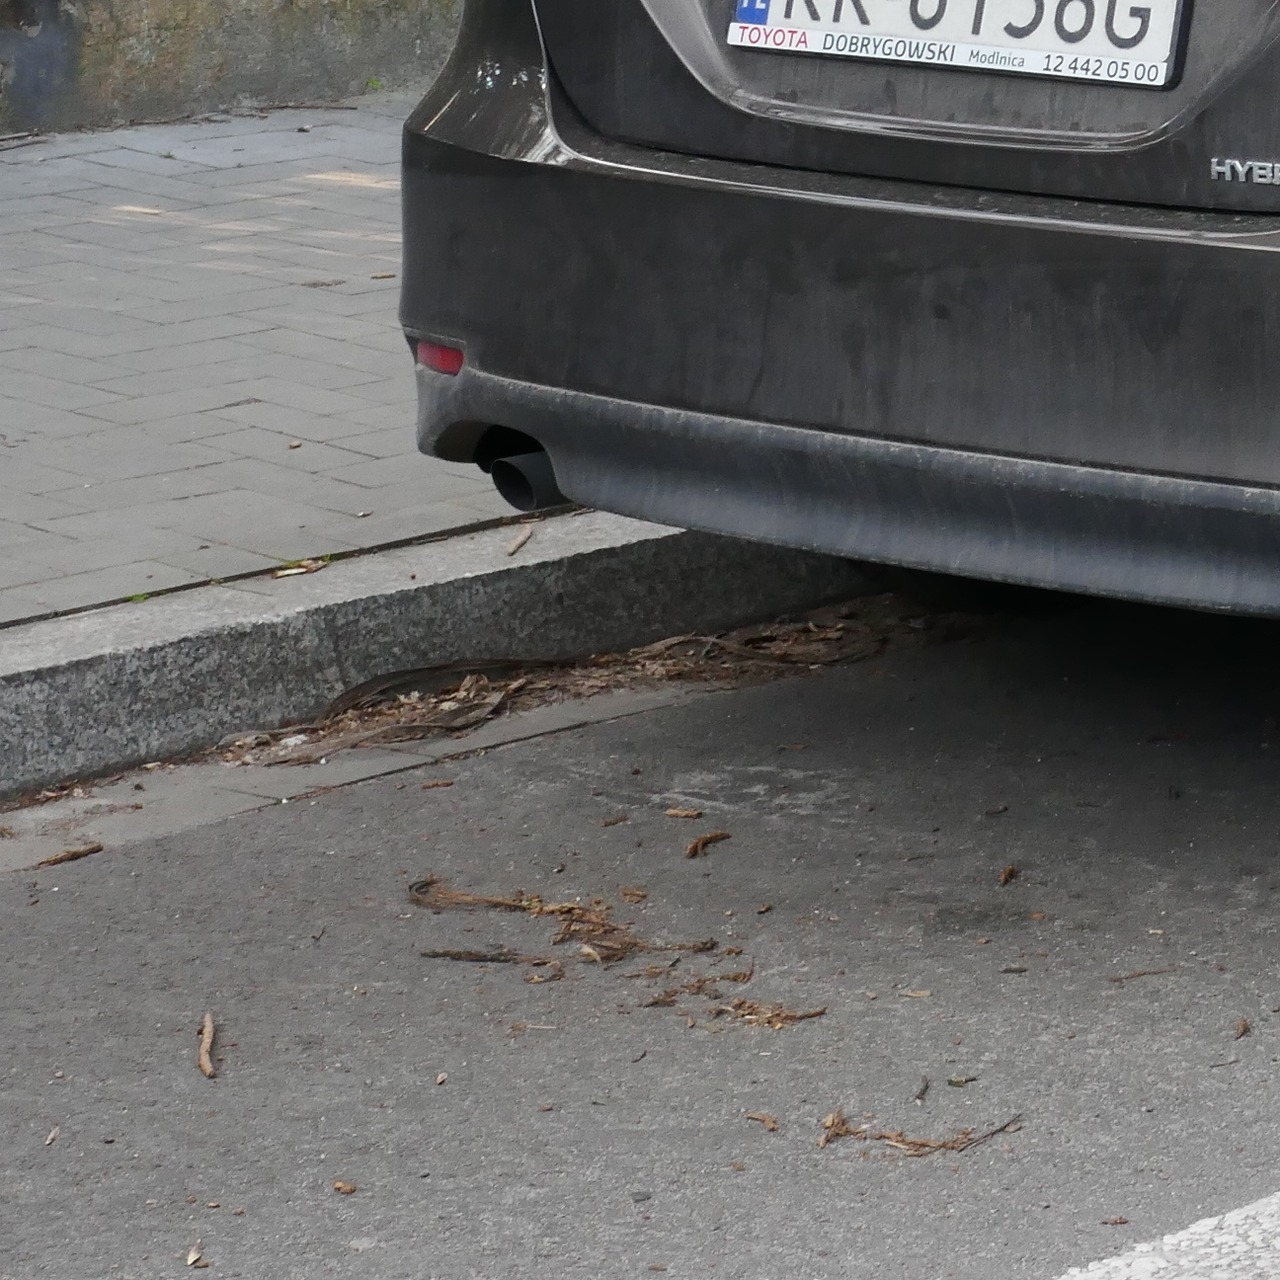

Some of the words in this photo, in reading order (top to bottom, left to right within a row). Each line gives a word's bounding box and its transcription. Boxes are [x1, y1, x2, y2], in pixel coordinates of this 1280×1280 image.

[739, 25, 809, 49] TOYOTA
[822, 33, 956, 62] DOBRYGOWSKI
[968, 49, 1025, 68] Modlnica
[1043, 54, 1065, 73] 12
[1068, 57, 1102, 77] 442
[1106, 60, 1130, 79] 05
[1134, 63, 1159, 82] 00
